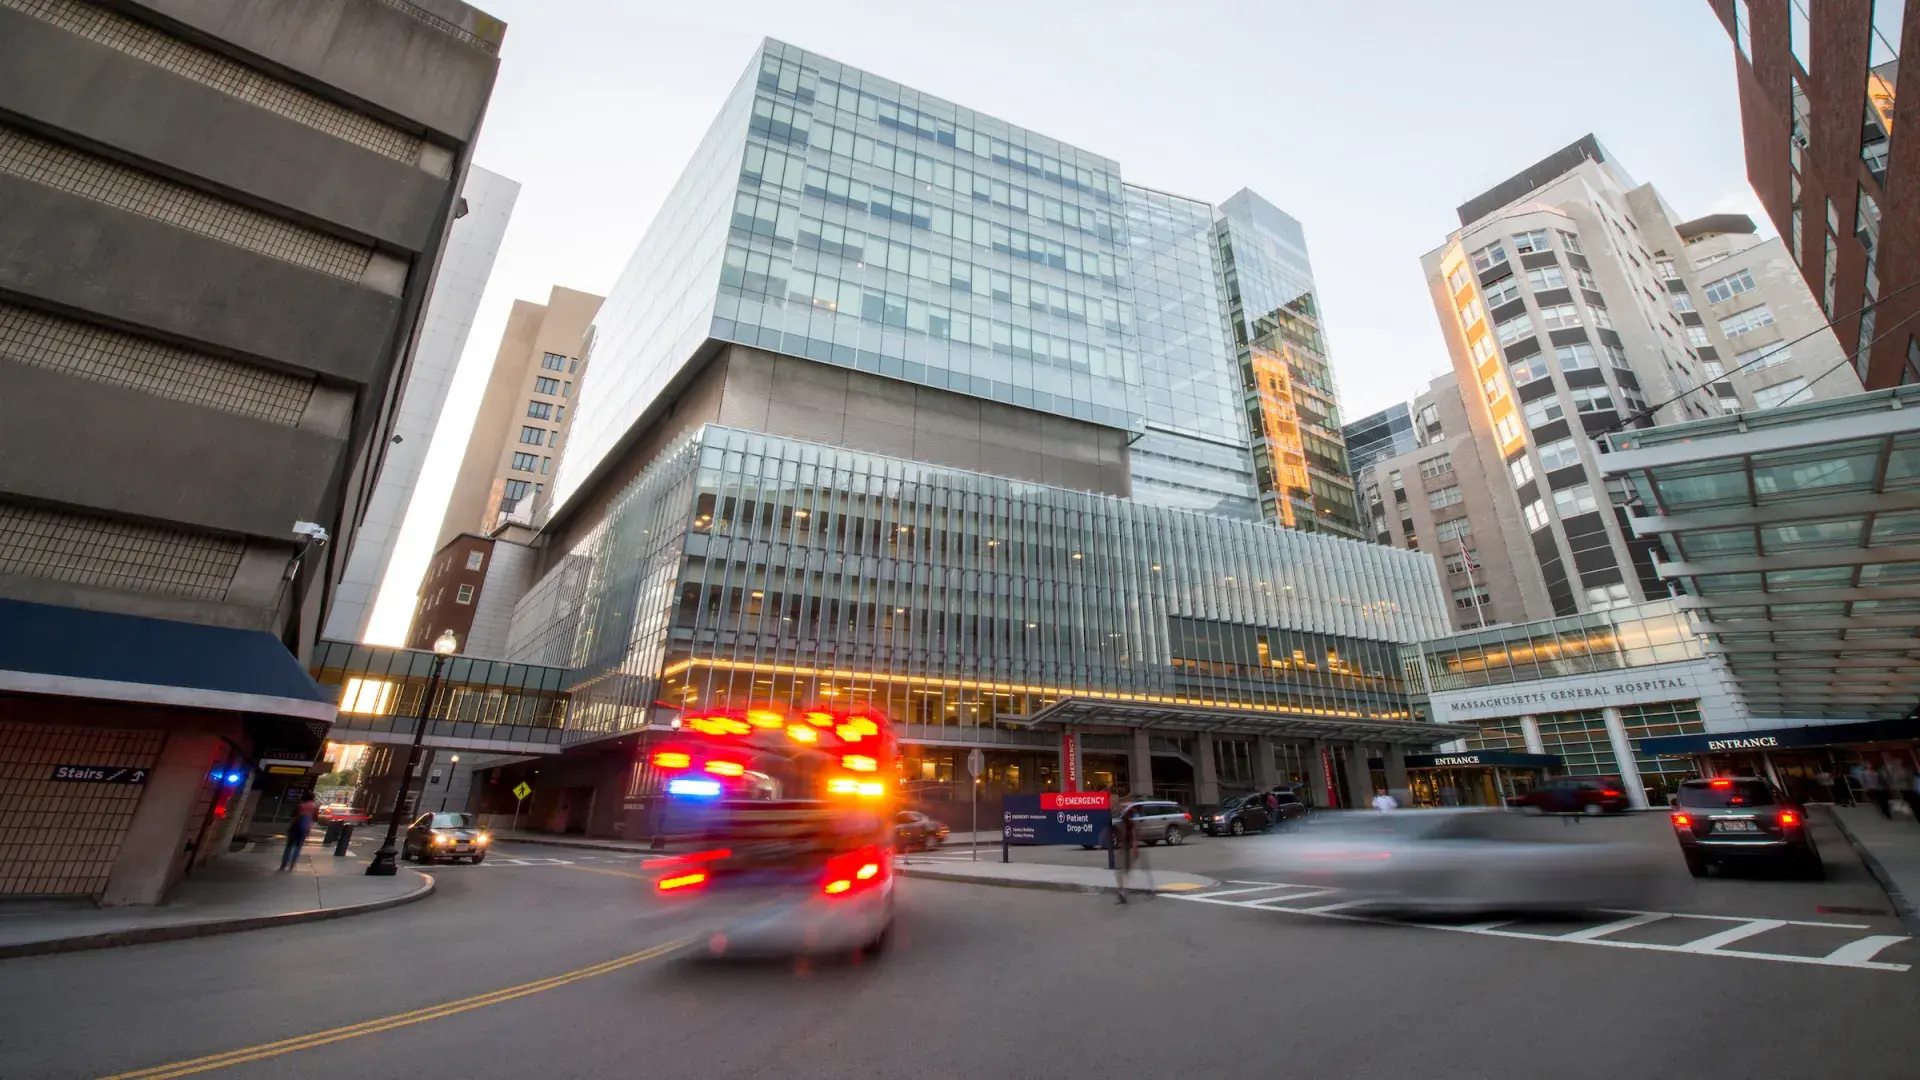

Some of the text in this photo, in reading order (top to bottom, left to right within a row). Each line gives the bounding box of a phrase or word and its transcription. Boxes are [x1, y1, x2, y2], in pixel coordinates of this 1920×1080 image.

[1451, 678, 1687, 710] MASSACHUSETTS GENERAL HOSPITAL
[1707, 736, 1778, 750] ENTRANCE
[1434, 755, 1480, 766] ENTRANCE
[56, 767, 104, 780] Stairs
[1064, 796, 1105, 806] EMERGENCY
[1066, 814, 1089, 823] Patient
[1067, 824, 1094, 834] Drop-Off
